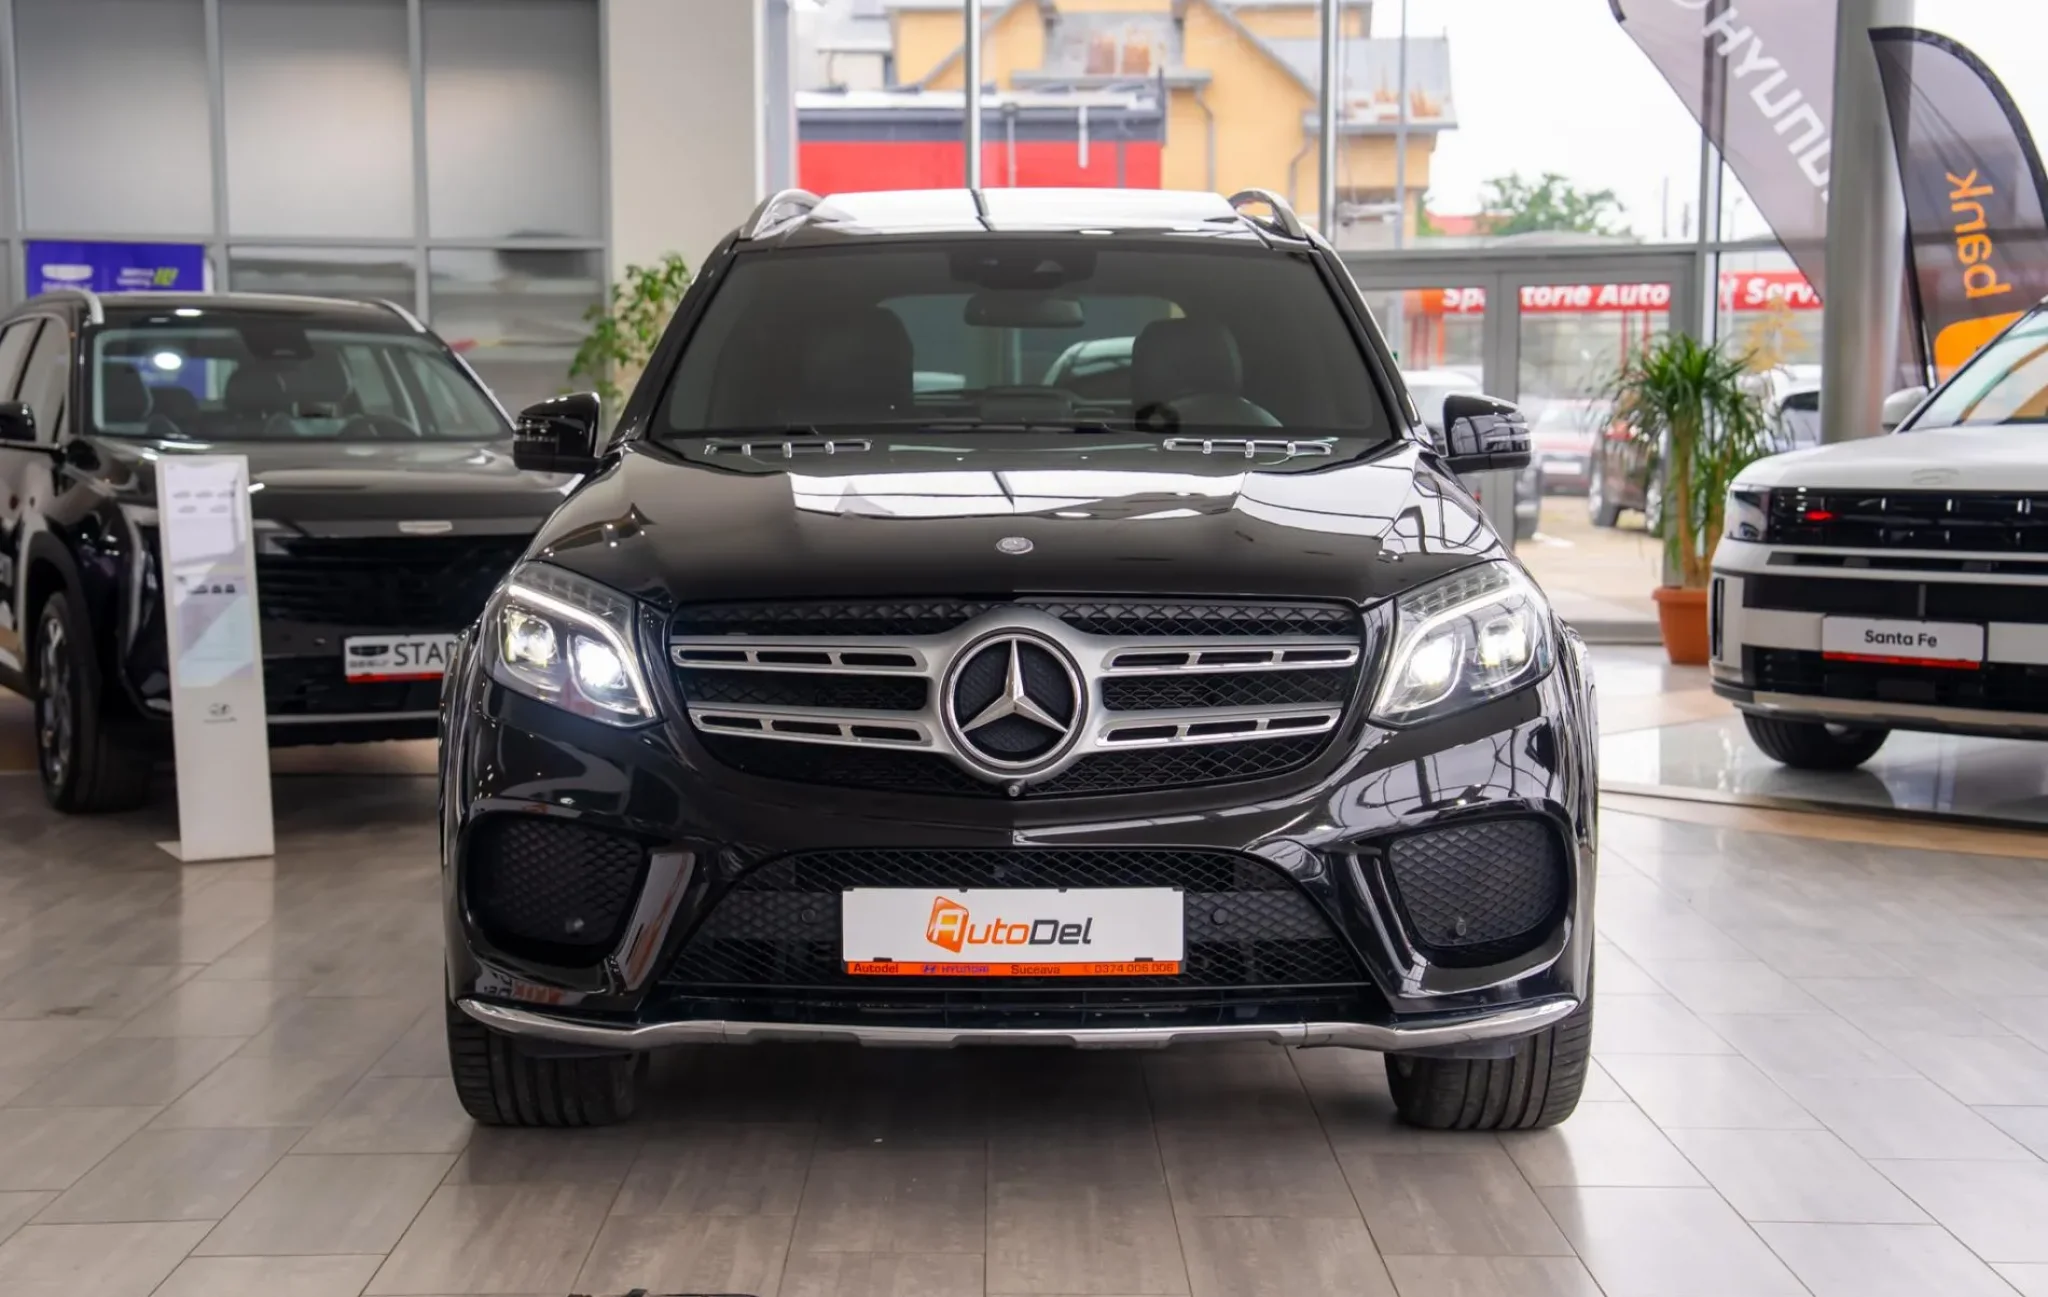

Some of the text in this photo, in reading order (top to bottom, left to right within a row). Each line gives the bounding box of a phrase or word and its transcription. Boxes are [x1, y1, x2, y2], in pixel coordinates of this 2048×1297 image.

[1701, 6, 1831, 203] HYUND
[1598, 284, 1670, 305] Auto
[1864, 629, 1938, 648] Santa Fe
[927, 903, 1093, 948] AutoDel
[853, 962, 899, 974] Autodel
[1011, 965, 1060, 975] Suceava
[1094, 965, 1124, 974] 0374
[1127, 964, 1149, 973] 006
[1152, 963, 1174, 972] 006
